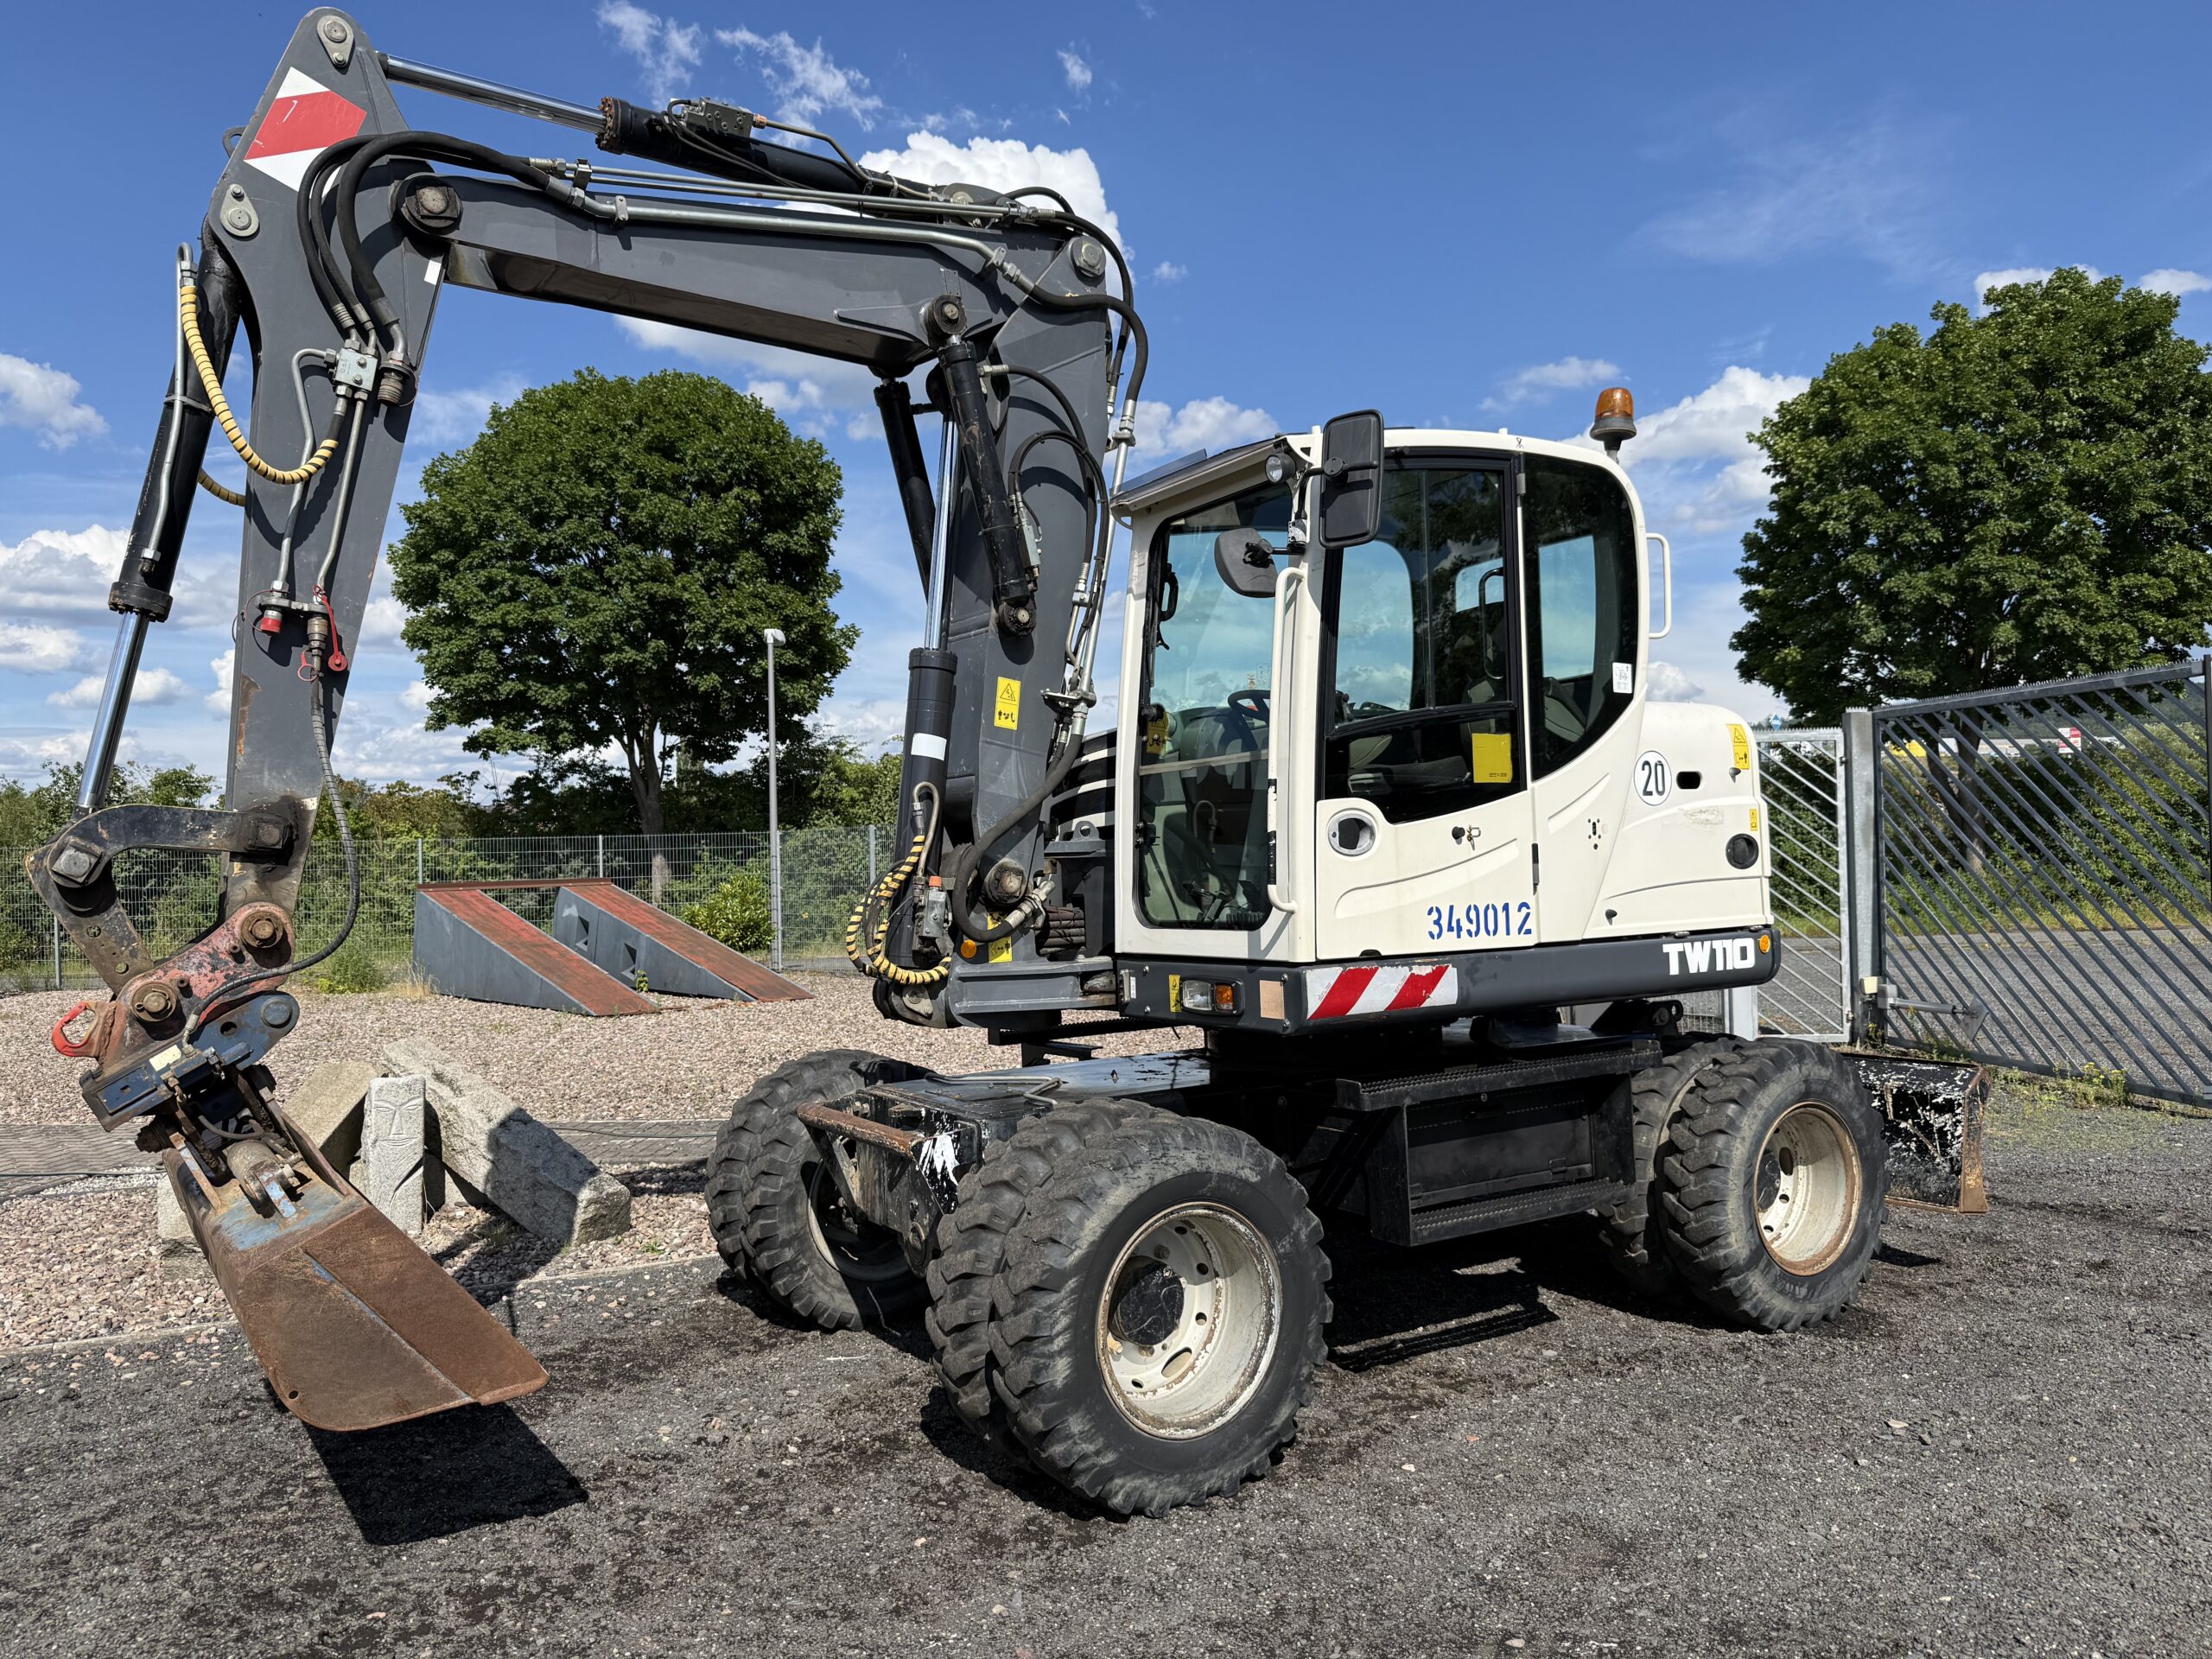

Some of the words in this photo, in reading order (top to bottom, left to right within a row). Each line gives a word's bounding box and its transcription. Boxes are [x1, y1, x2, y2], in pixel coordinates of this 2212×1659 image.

[1642, 760, 1666, 796] 20
[1427, 901, 1533, 940] 349012
[1662, 938, 1756, 976] TW110
